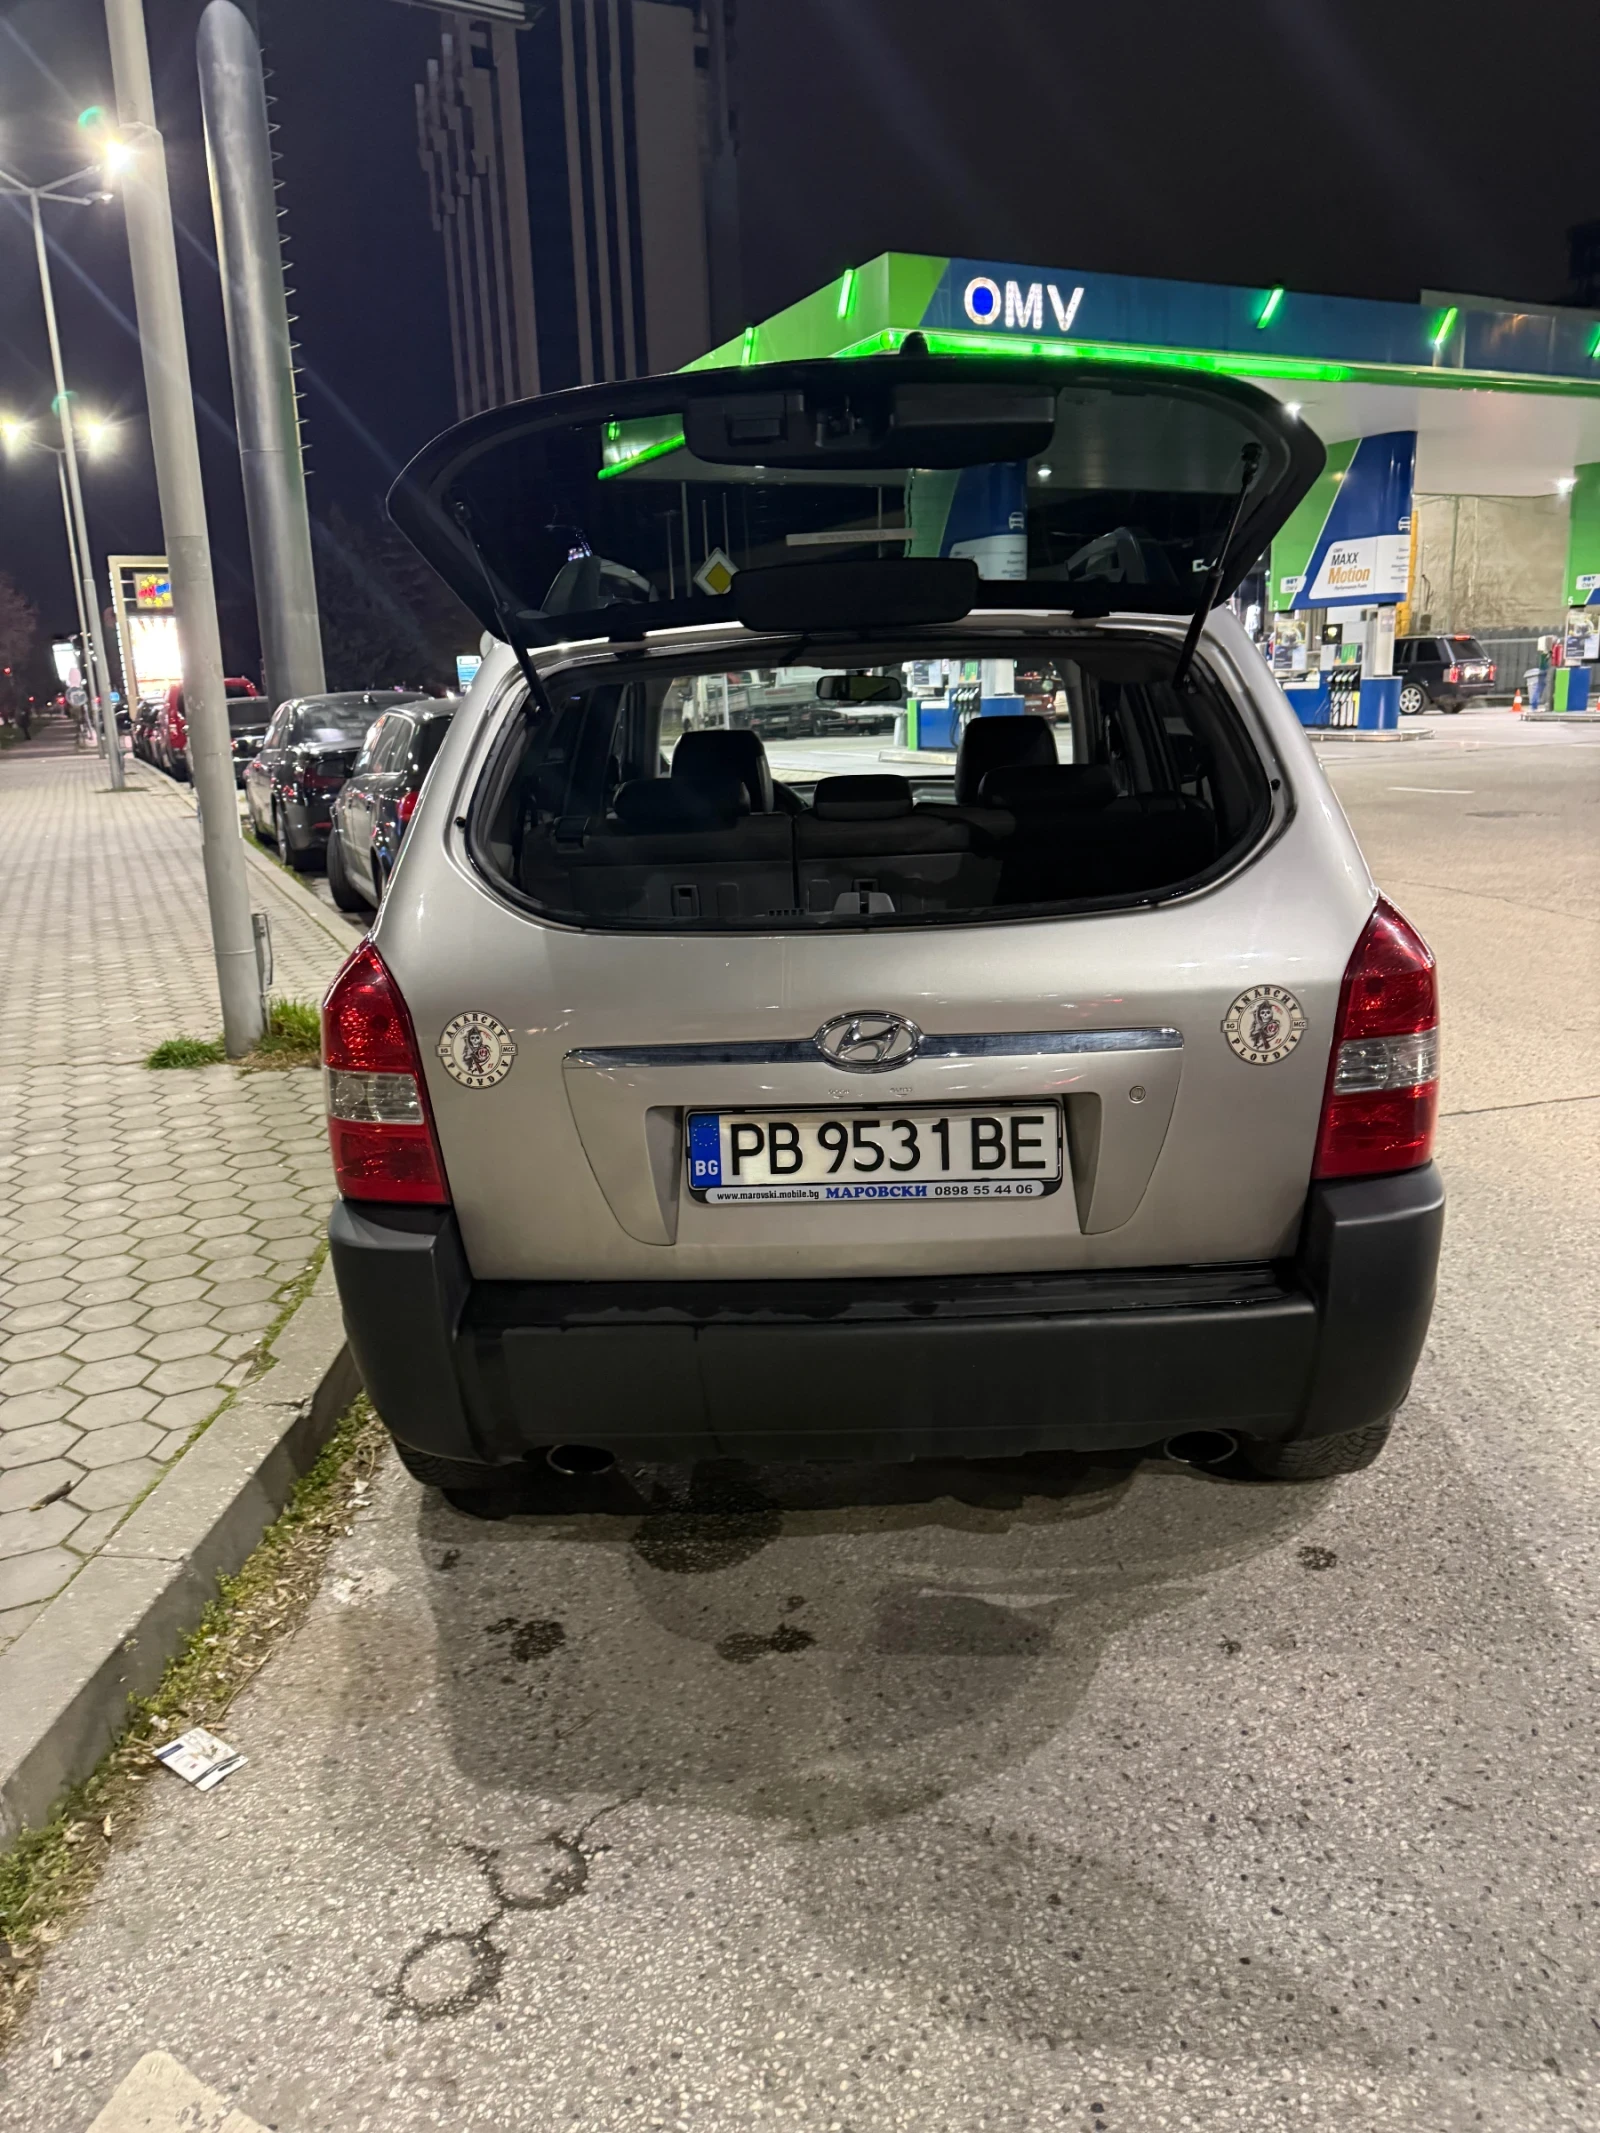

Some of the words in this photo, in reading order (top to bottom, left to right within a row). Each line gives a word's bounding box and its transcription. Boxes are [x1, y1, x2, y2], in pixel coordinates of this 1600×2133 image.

[963, 276, 1085, 332] OMV
[1331, 552, 1360, 566] MAXX
[1328, 565, 1371, 585] Motion
[1273, 600, 1279, 611] 3
[1234, 987, 1299, 1014] ANARCHY
[445, 1013, 506, 1039] ANARCHY
[1231, 1035, 1298, 1063] PLOVDIV
[446, 1060, 509, 1086] PLOVDIV
[730, 1121, 803, 1176] PB
[817, 1117, 951, 1174] 9531
[971, 1115, 1047, 1171] BE
[695, 1159, 719, 1177] BG
[716, 1189, 820, 1201] www.marovski.mobile.bg
[825, 1185, 928, 1199] МАРОВСКИ
[934, 1186, 969, 1196] 0898
[973, 1185, 990, 1195] 55
[994, 1184, 1012, 1194] 44
[1016, 1184, 1033, 1194] 06
